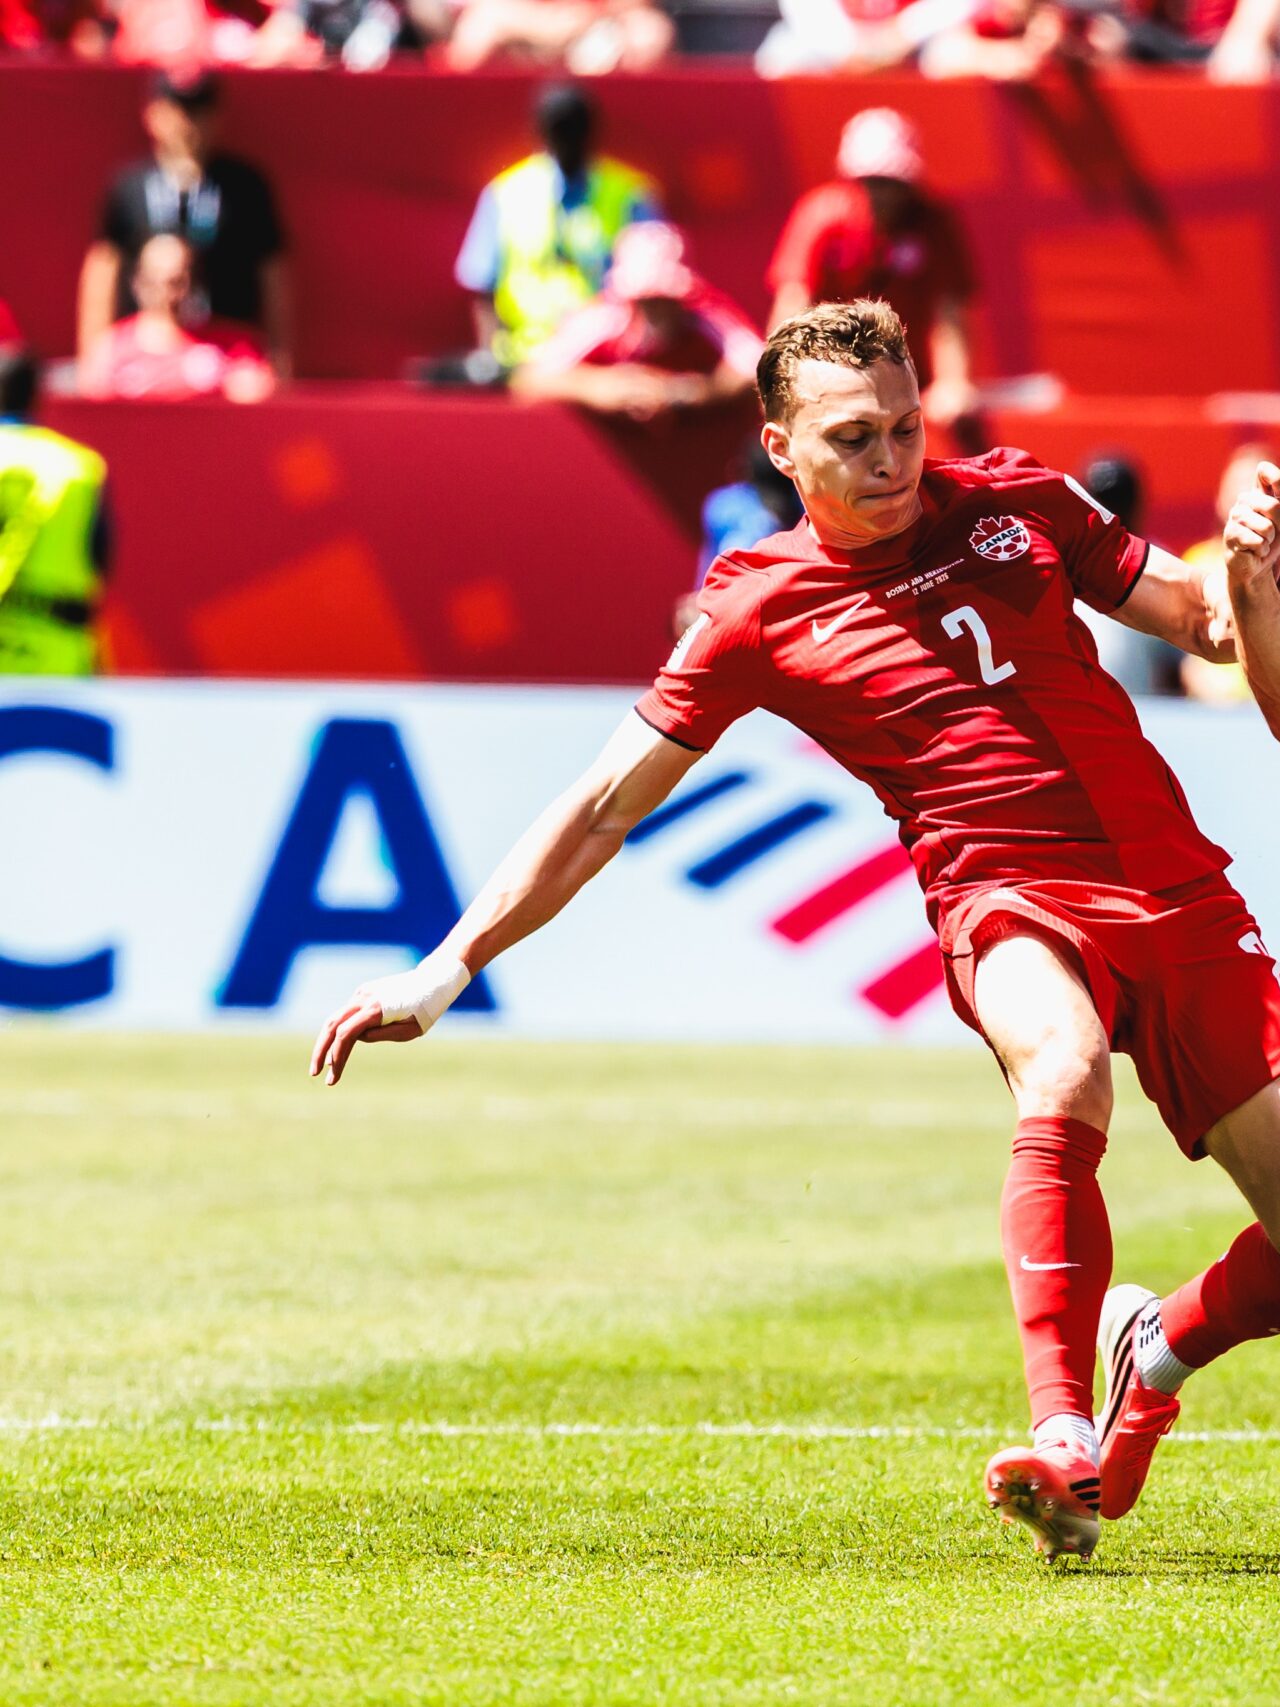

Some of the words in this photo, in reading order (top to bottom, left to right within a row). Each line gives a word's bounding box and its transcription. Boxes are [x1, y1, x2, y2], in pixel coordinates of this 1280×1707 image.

[976, 526, 1024, 554] CANADA
[885, 582, 910, 599] BOSNIA
[910, 575, 924, 587] AND
[911, 587, 919, 596] 12
[920, 580, 935, 592] JUNE
[940, 605, 1018, 687] 2
